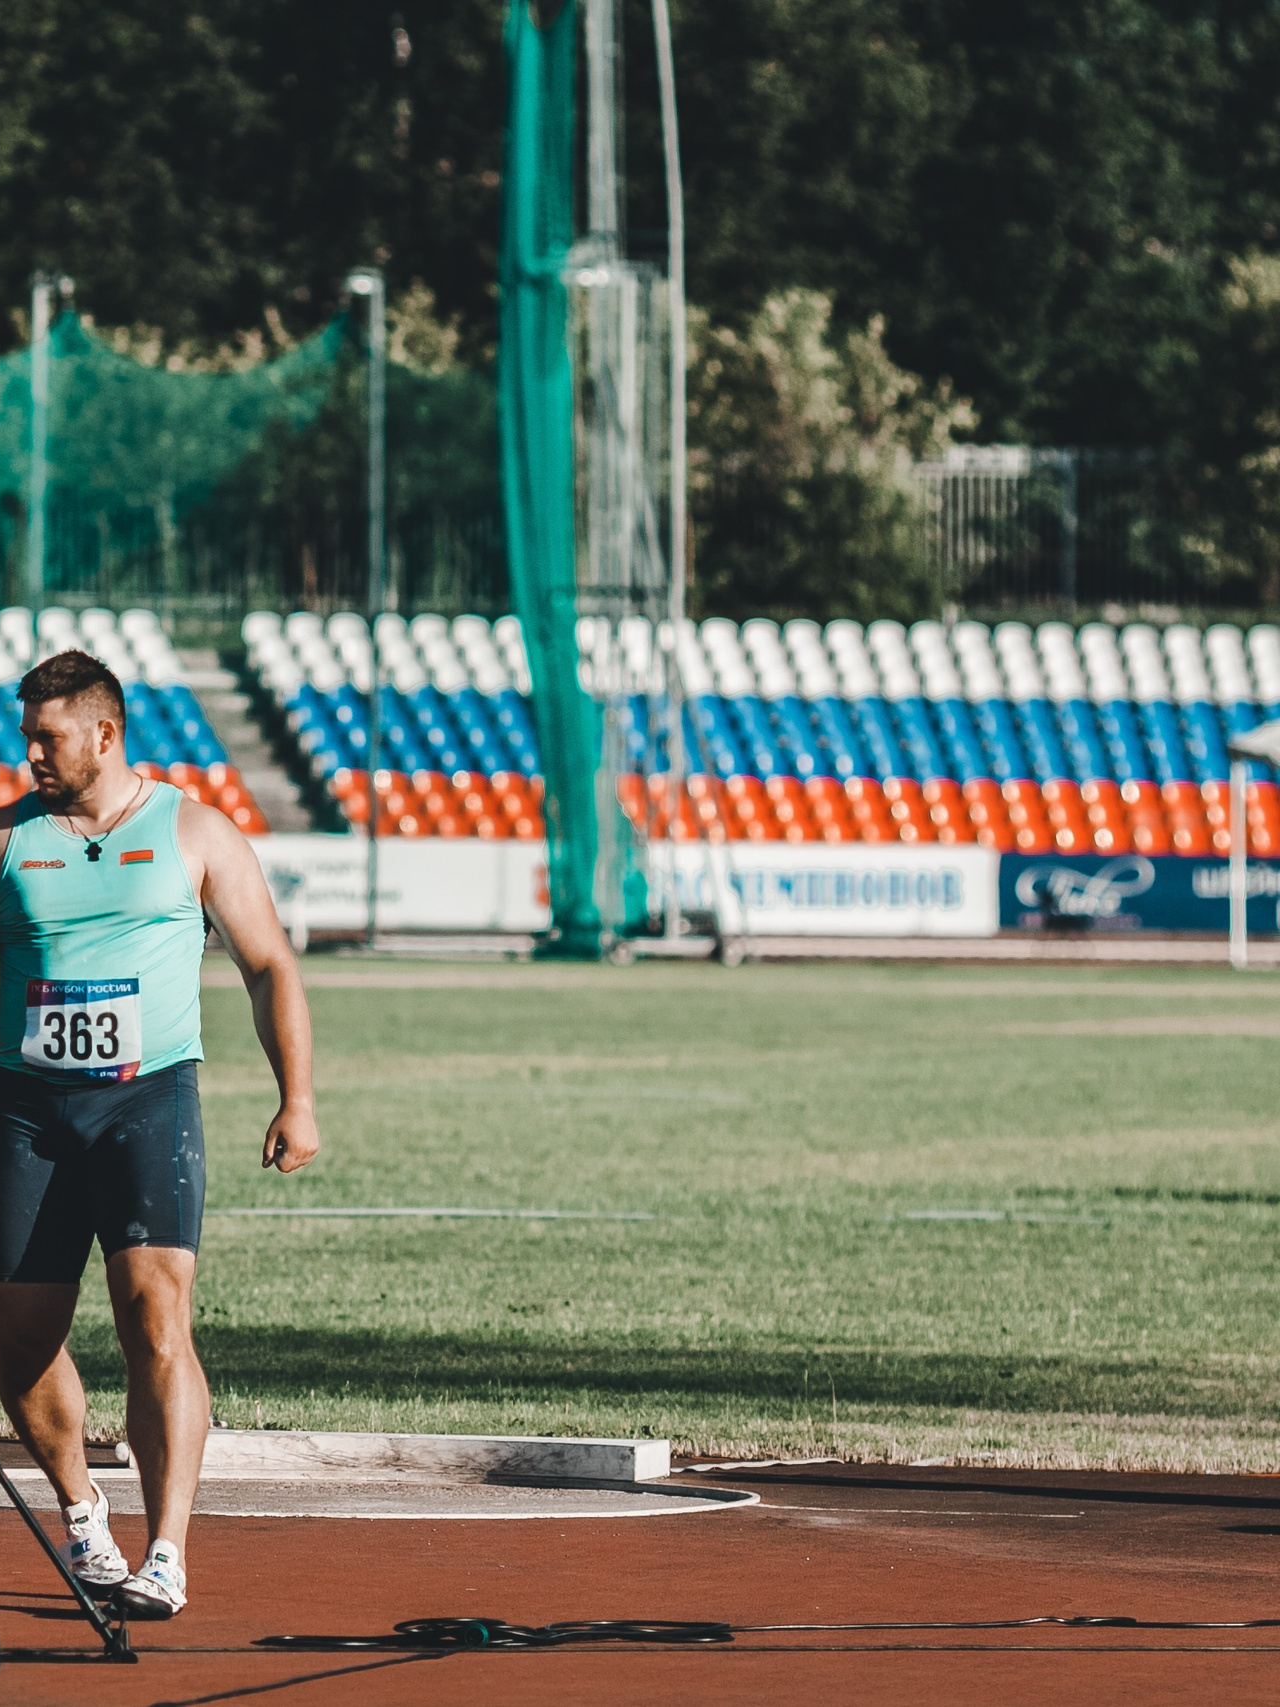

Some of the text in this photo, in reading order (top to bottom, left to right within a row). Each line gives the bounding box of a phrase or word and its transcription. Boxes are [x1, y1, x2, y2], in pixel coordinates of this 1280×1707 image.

[52, 984, 85, 993] КУБОК
[88, 983, 131, 994] РОССИИ
[43, 1012, 119, 1061] 363
